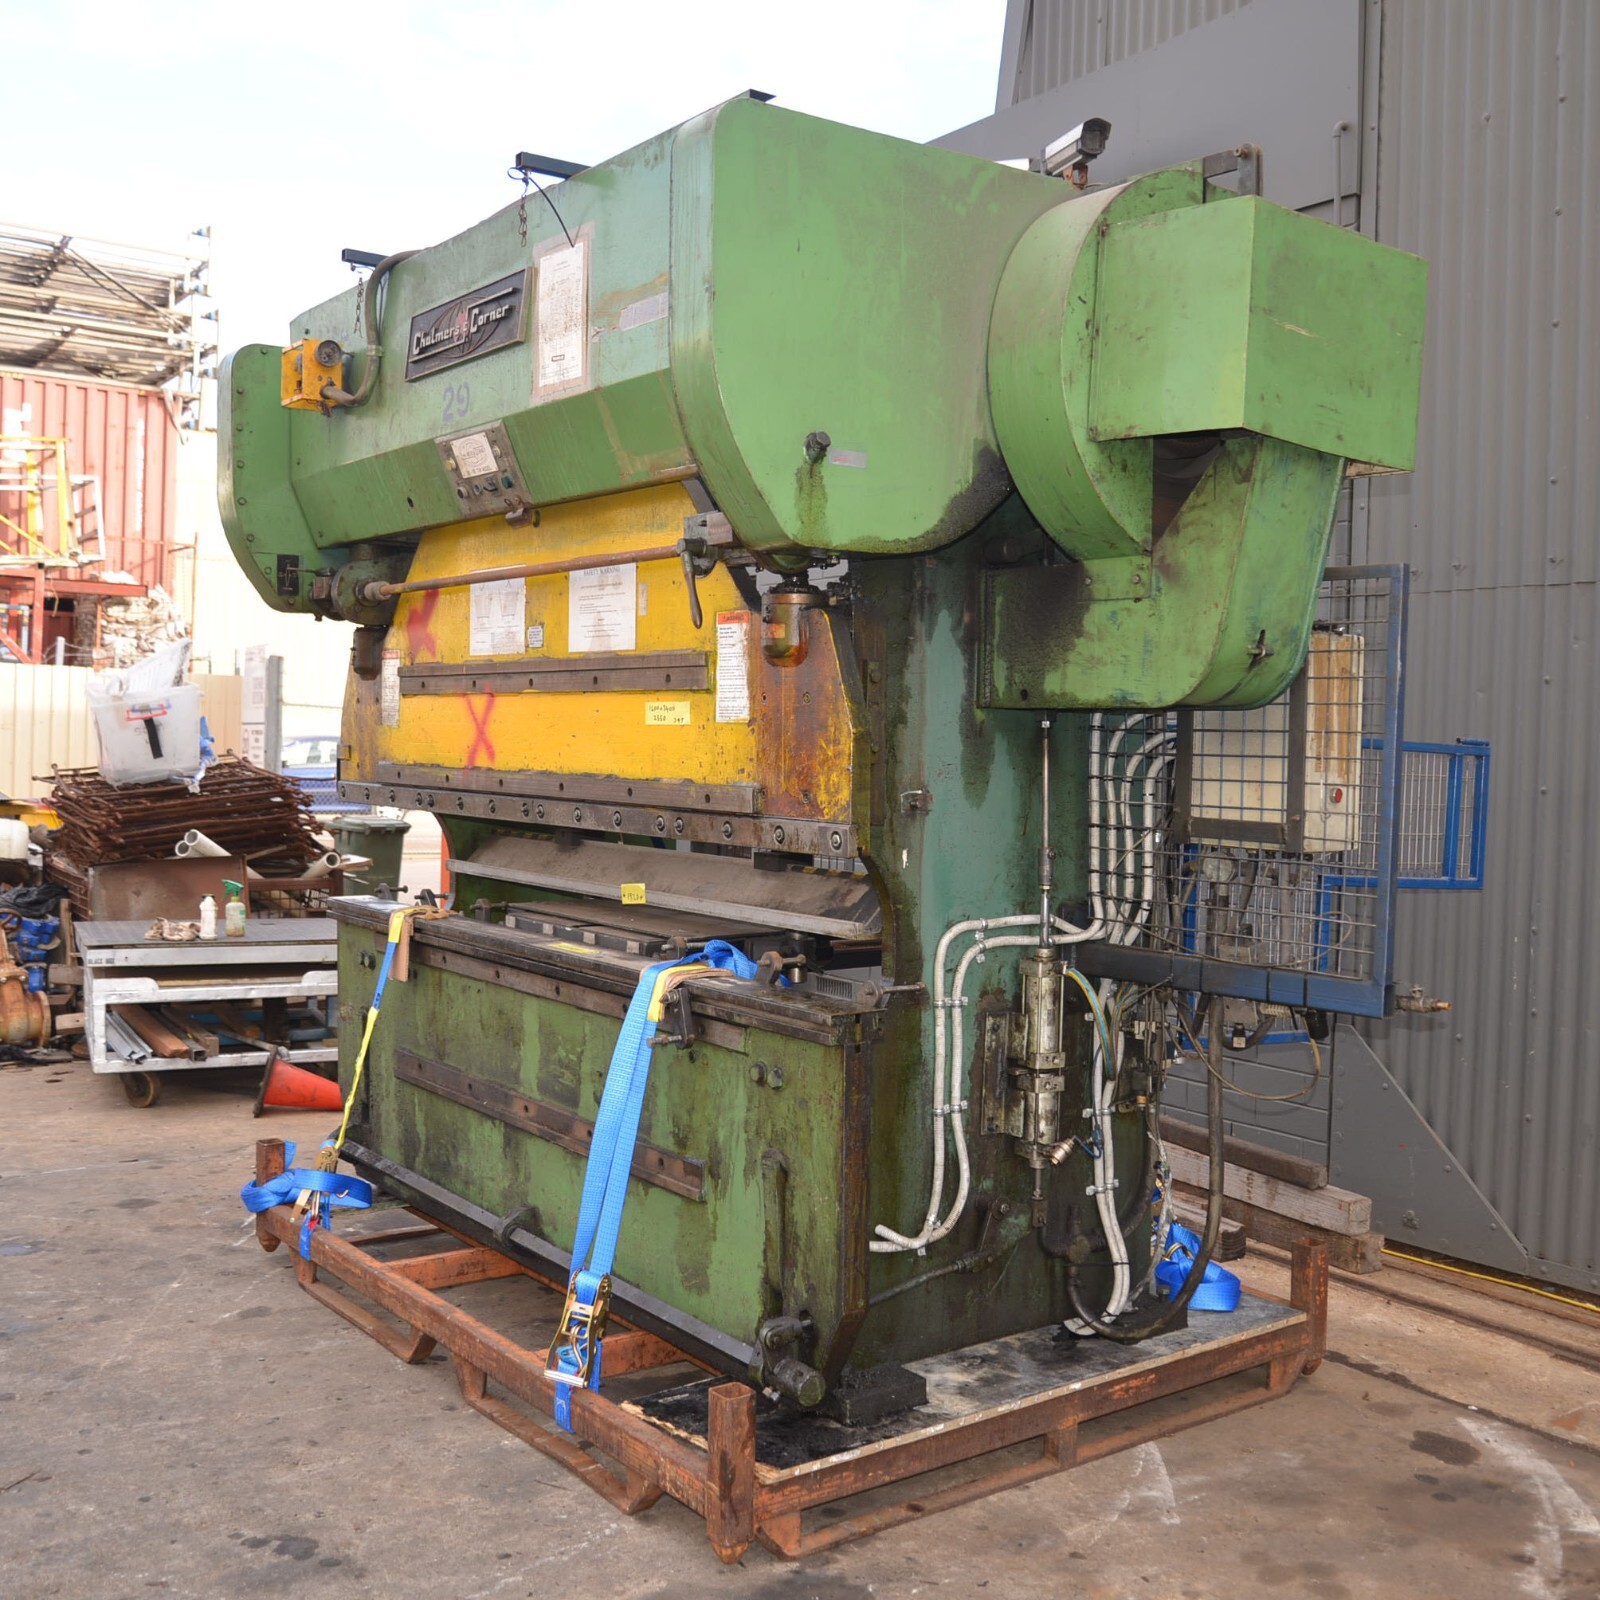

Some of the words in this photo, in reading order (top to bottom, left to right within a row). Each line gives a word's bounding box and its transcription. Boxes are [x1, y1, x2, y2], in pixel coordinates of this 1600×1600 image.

[412, 324, 460, 355] Chalmers
[470, 304, 510, 333] Corner
[442, 382, 470, 421] 29
